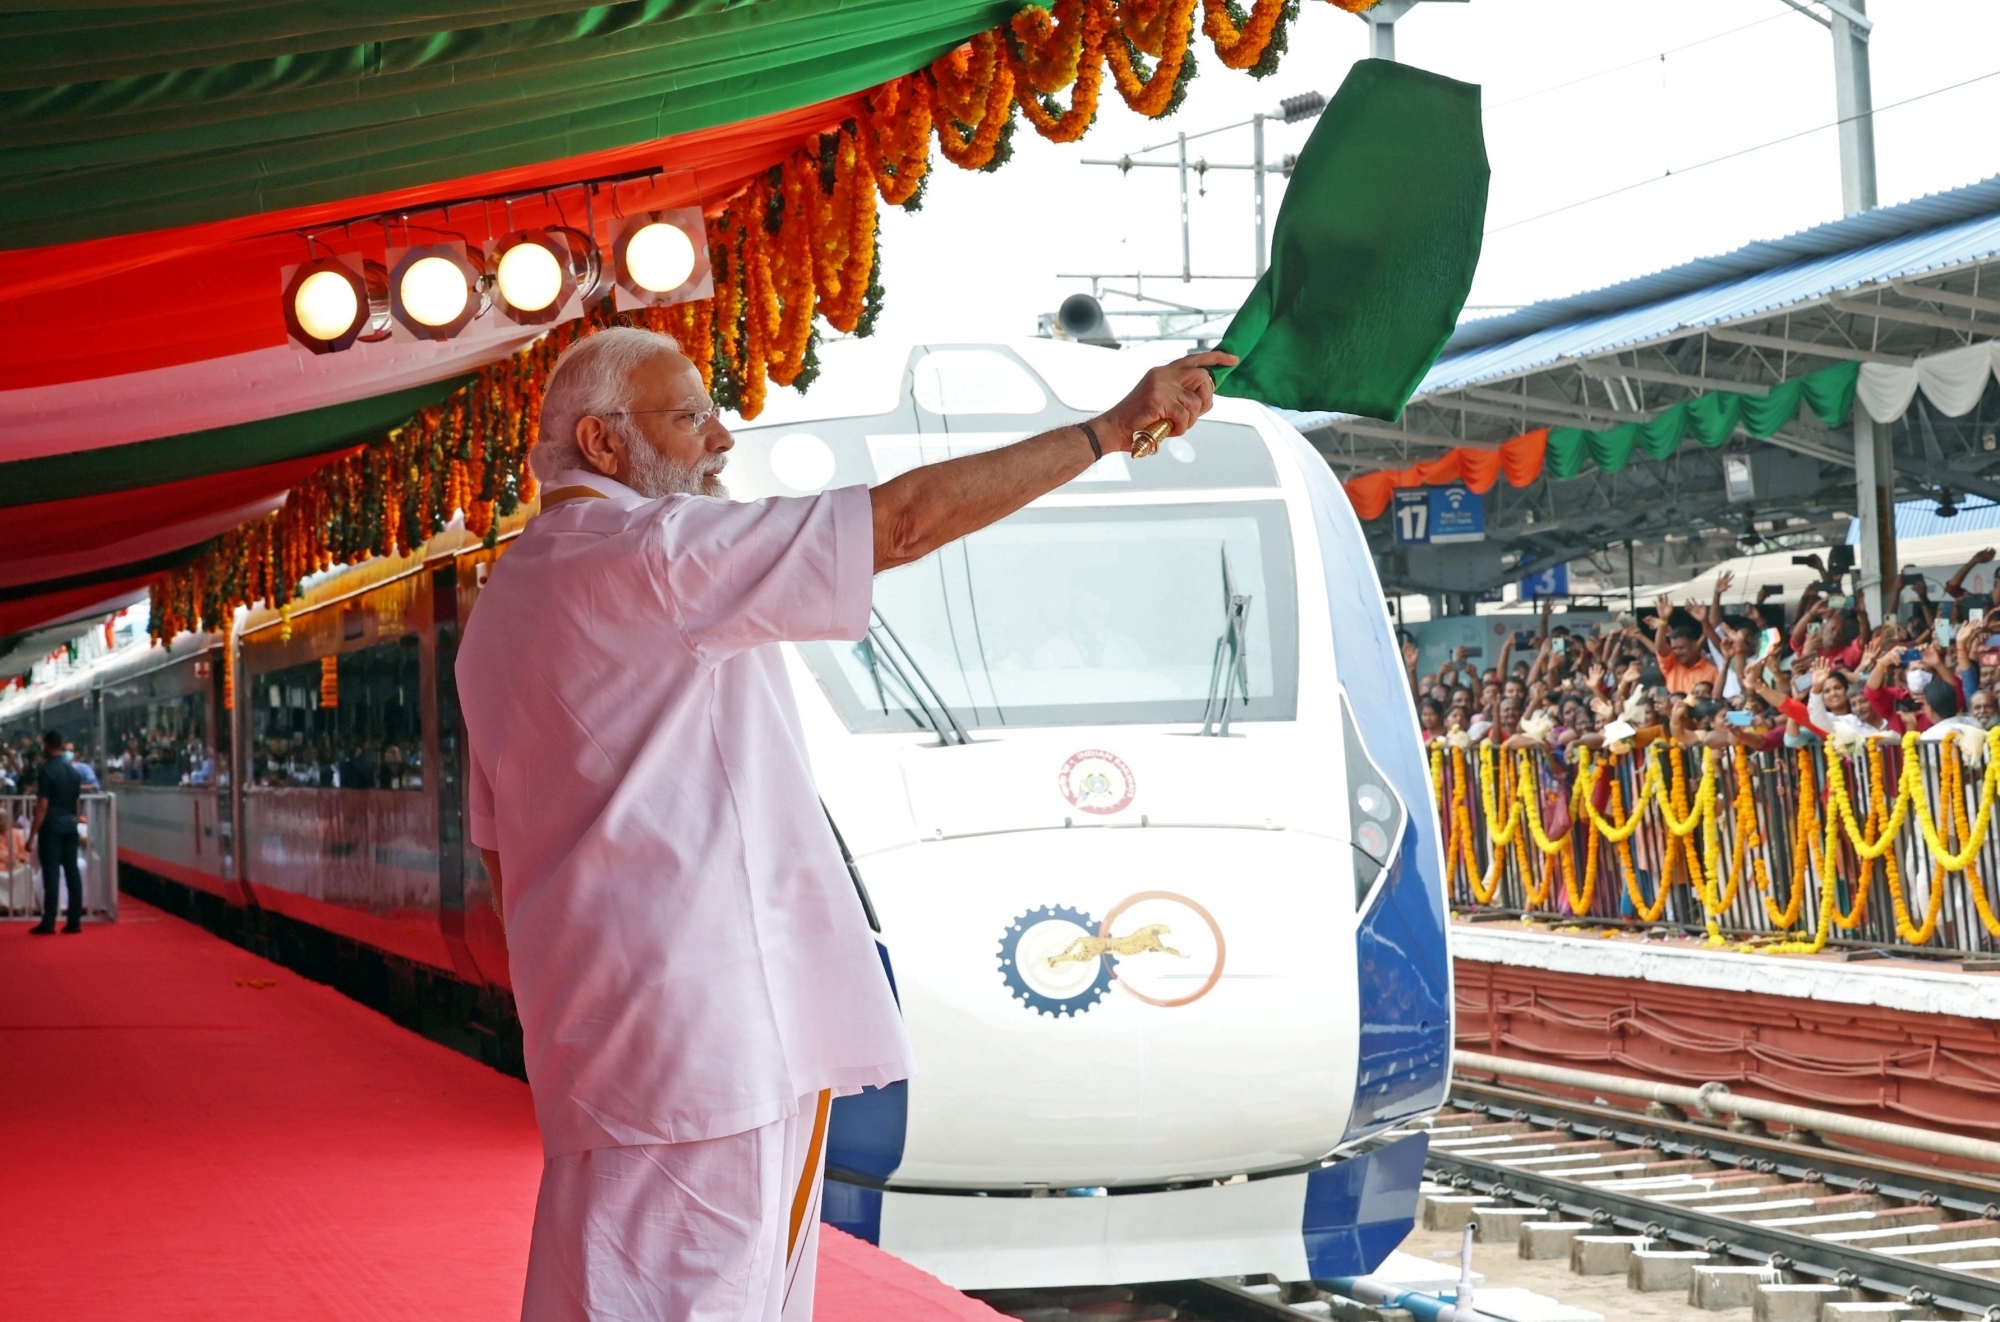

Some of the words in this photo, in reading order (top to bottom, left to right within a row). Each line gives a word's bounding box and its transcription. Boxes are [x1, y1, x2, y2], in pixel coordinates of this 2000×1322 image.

[1397, 505, 1428, 540] 17
[1534, 568, 1556, 594] 3
[1077, 750, 1114, 761] INDIAN
